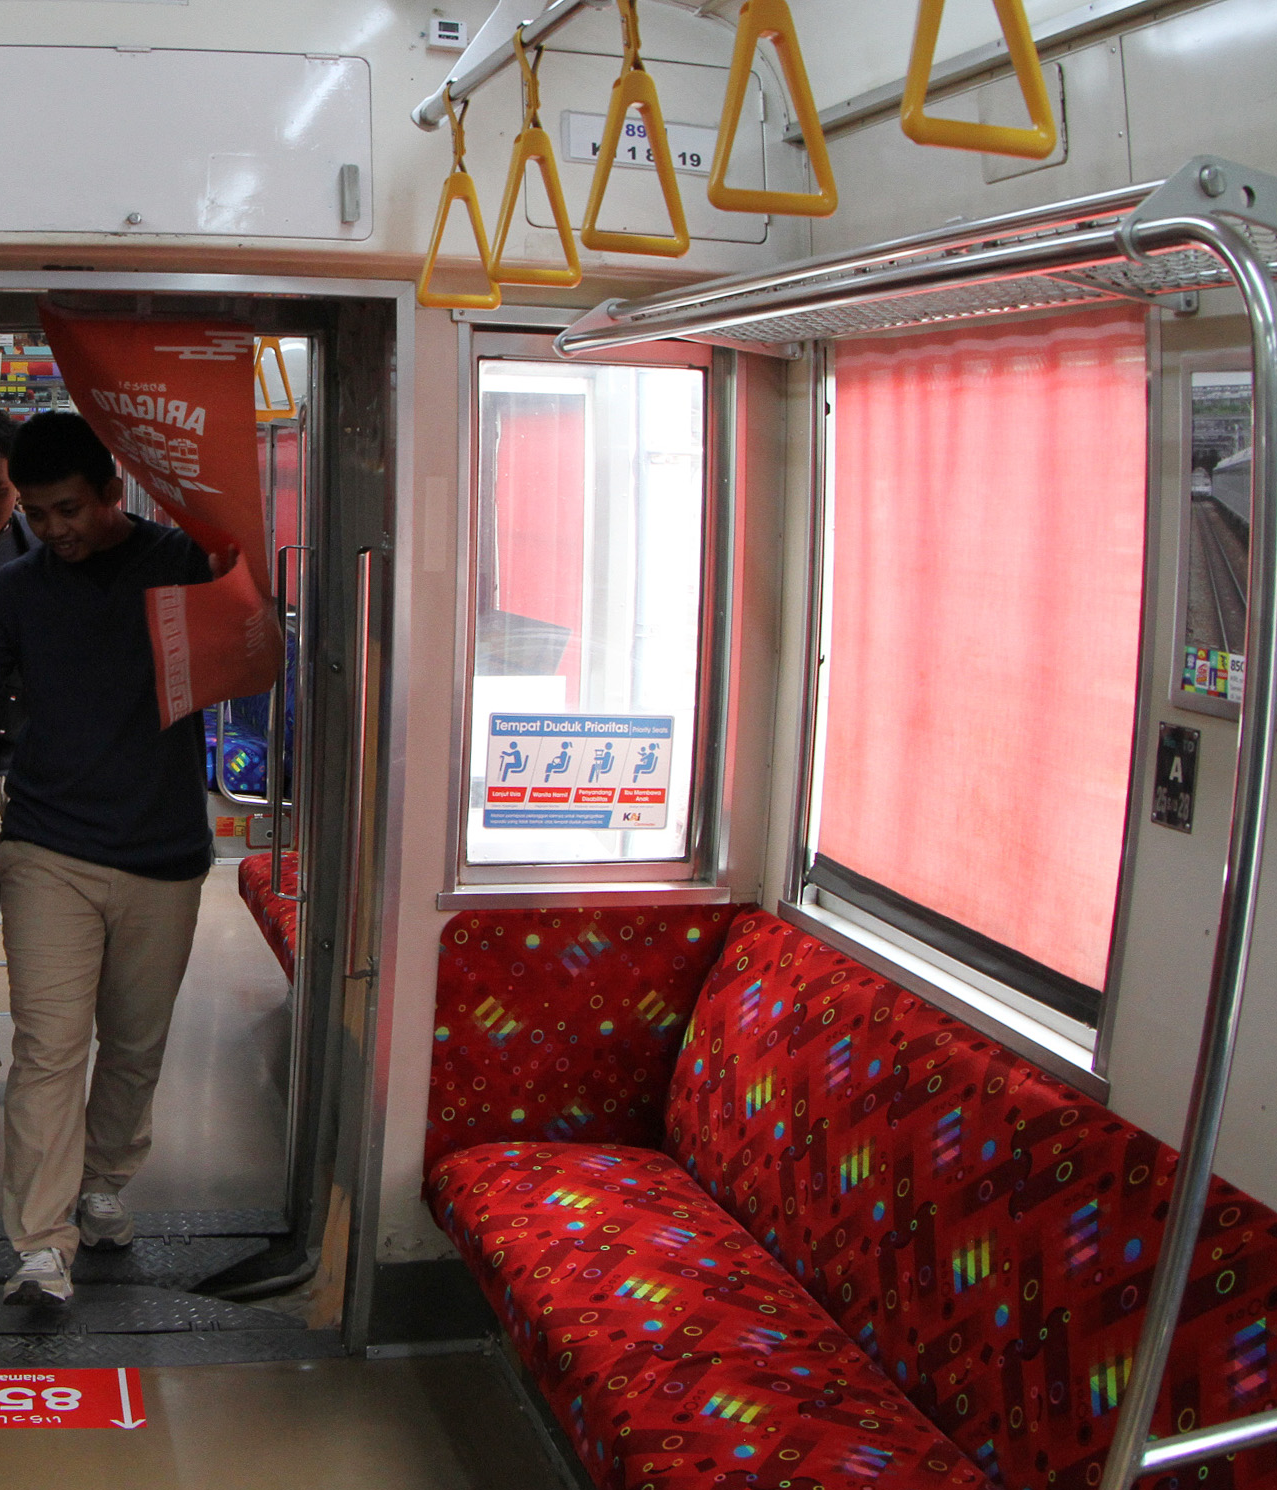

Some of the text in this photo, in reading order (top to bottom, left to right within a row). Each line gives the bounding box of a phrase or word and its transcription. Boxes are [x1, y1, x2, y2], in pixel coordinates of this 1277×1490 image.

[678, 152, 702, 167] 19
[495, 719, 629, 733] Tempat Duduk Prioritas
[632, 726, 651, 735] Priority
[1169, 756, 1183, 783] A
